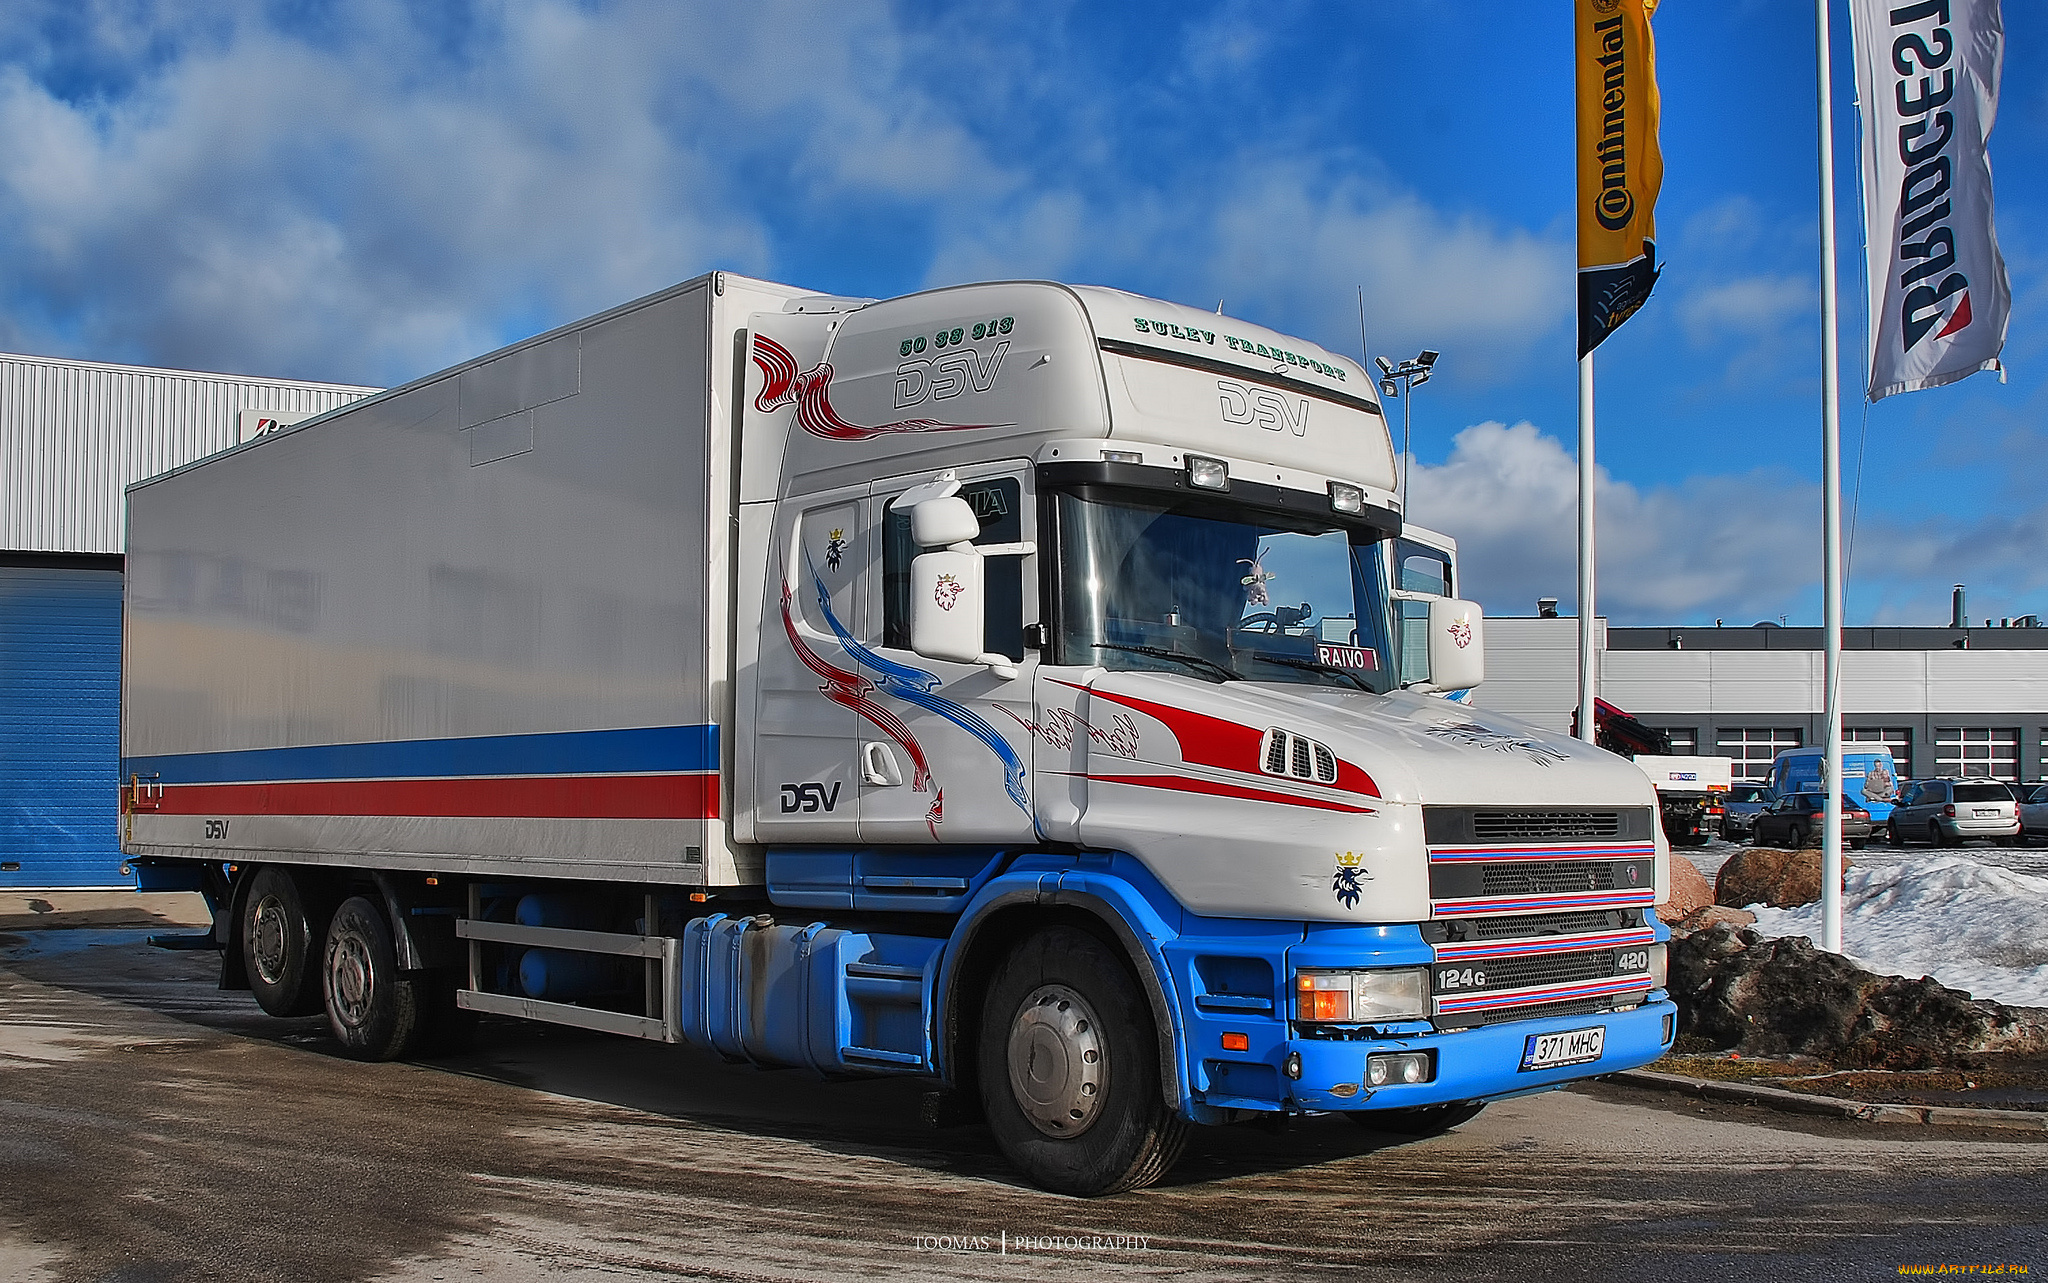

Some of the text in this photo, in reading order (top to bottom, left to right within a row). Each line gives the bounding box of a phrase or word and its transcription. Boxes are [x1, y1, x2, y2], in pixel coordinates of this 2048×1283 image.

[1594, 14, 1635, 232] Continental
[899, 316, 1015, 357] 50 38 913
[1134, 317, 1347, 382] SULEV TRANSPORT
[893, 340, 1011, 410] DSV
[1217, 380, 1309, 437] DSV
[1319, 647, 1365, 669] RAIVO
[780, 781, 842, 814] DSV
[205, 820, 230, 839] DSV
[1618, 951, 1648, 970] 420
[1438, 968, 1486, 989] 124G
[1538, 1031, 1600, 1060] 371 MHC
